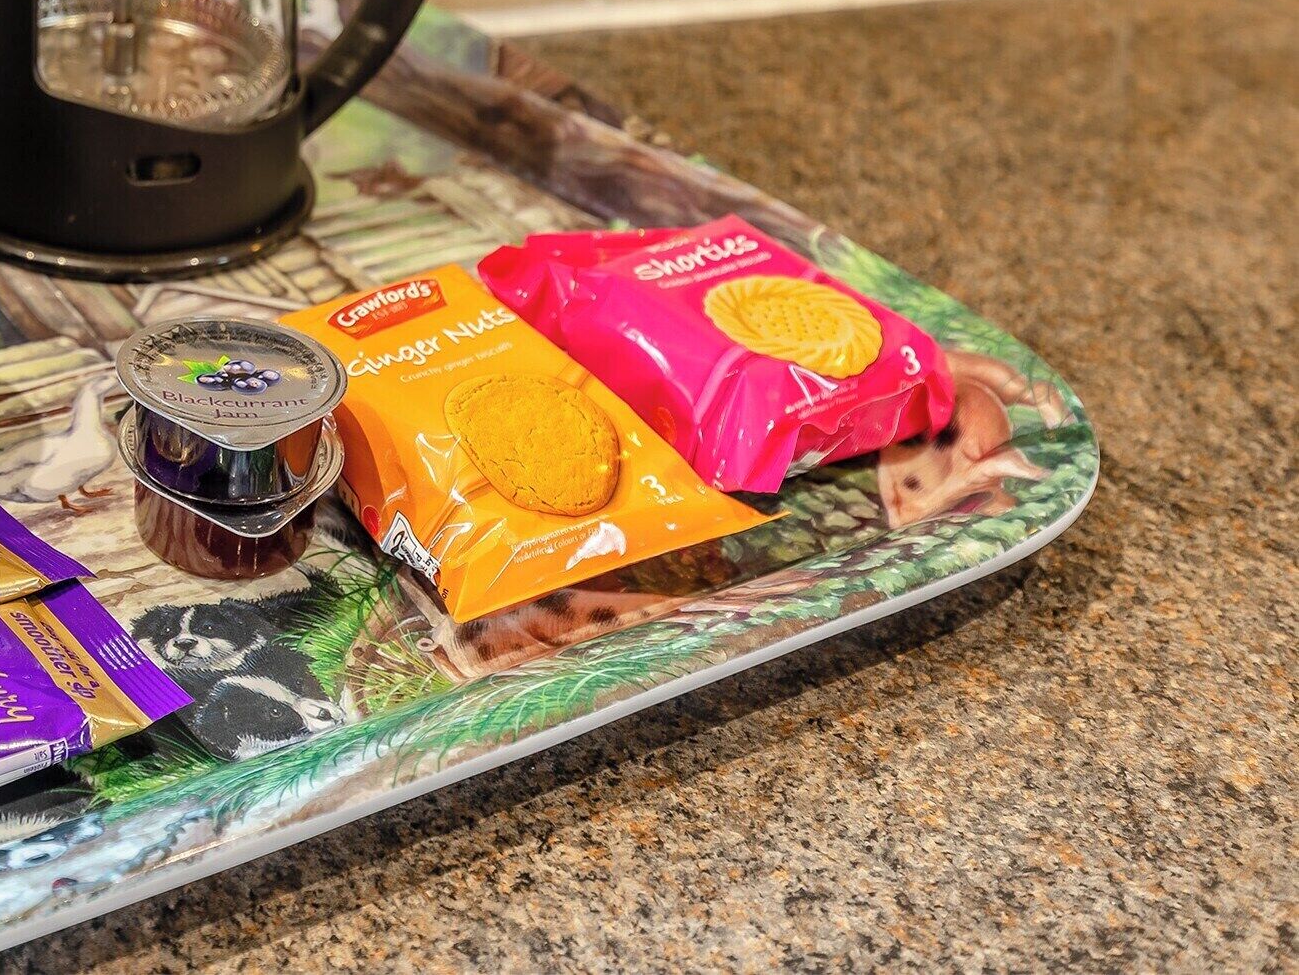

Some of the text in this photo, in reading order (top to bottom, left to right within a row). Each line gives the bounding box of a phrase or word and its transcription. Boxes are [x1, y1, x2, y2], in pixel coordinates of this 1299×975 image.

[634, 235, 758, 280] Shorties
[337, 282, 432, 327] Crawford's
[347, 337, 441, 377] Ginger
[443, 306, 516, 344] Nuts
[444, 355, 475, 372] ginger
[900, 345, 921, 376] 3
[162, 390, 309, 408] Blackcurrant
[213, 407, 259, 419] Jam
[640, 475, 666, 496] 3
[554, 535, 578, 549] Colours
[10, 612, 77, 678] smoother
[34, 750, 48, 761] Salt
